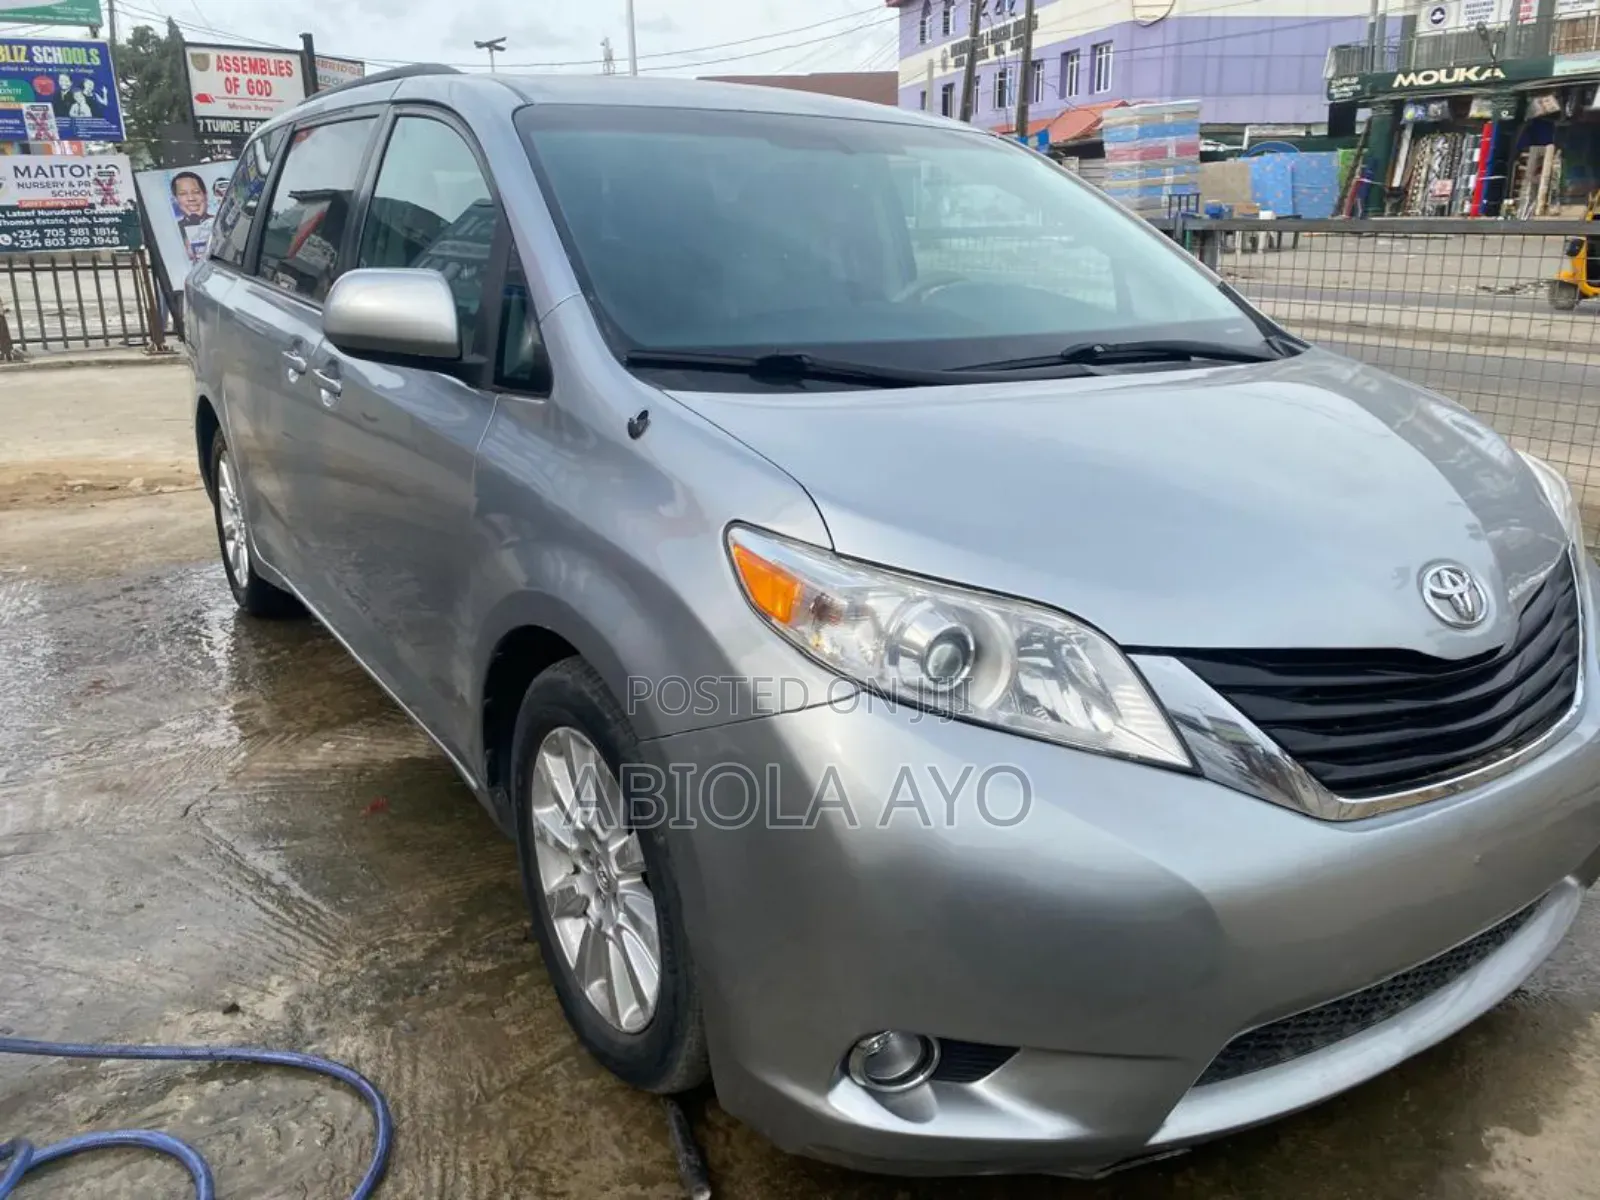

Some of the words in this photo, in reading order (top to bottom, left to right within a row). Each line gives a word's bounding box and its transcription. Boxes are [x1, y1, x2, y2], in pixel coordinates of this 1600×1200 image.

[32, 45, 101, 66] SCHOOLS
[216, 54, 294, 77] ASSEMBLIES
[1392, 66, 1506, 88] MOUKA
[225, 77, 240, 95] OF
[246, 78, 272, 97] GOD
[205, 119, 241, 133] TUNDE
[17, 181, 65, 189] NURSERY
[51, 189, 94, 197] SCHOOL
[7, 209, 35, 217] Lateef
[38, 209, 82, 217] Nurudeen
[12, 229, 40, 239] +234
[44, 227, 66, 238] 705
[69, 227, 90, 237] 981
[94, 226, 119, 237] 1814
[14, 239, 42, 248] +234
[44, 238, 66, 247] 803
[68, 237, 90, 246] 309
[92, 235, 120, 246] 1948
